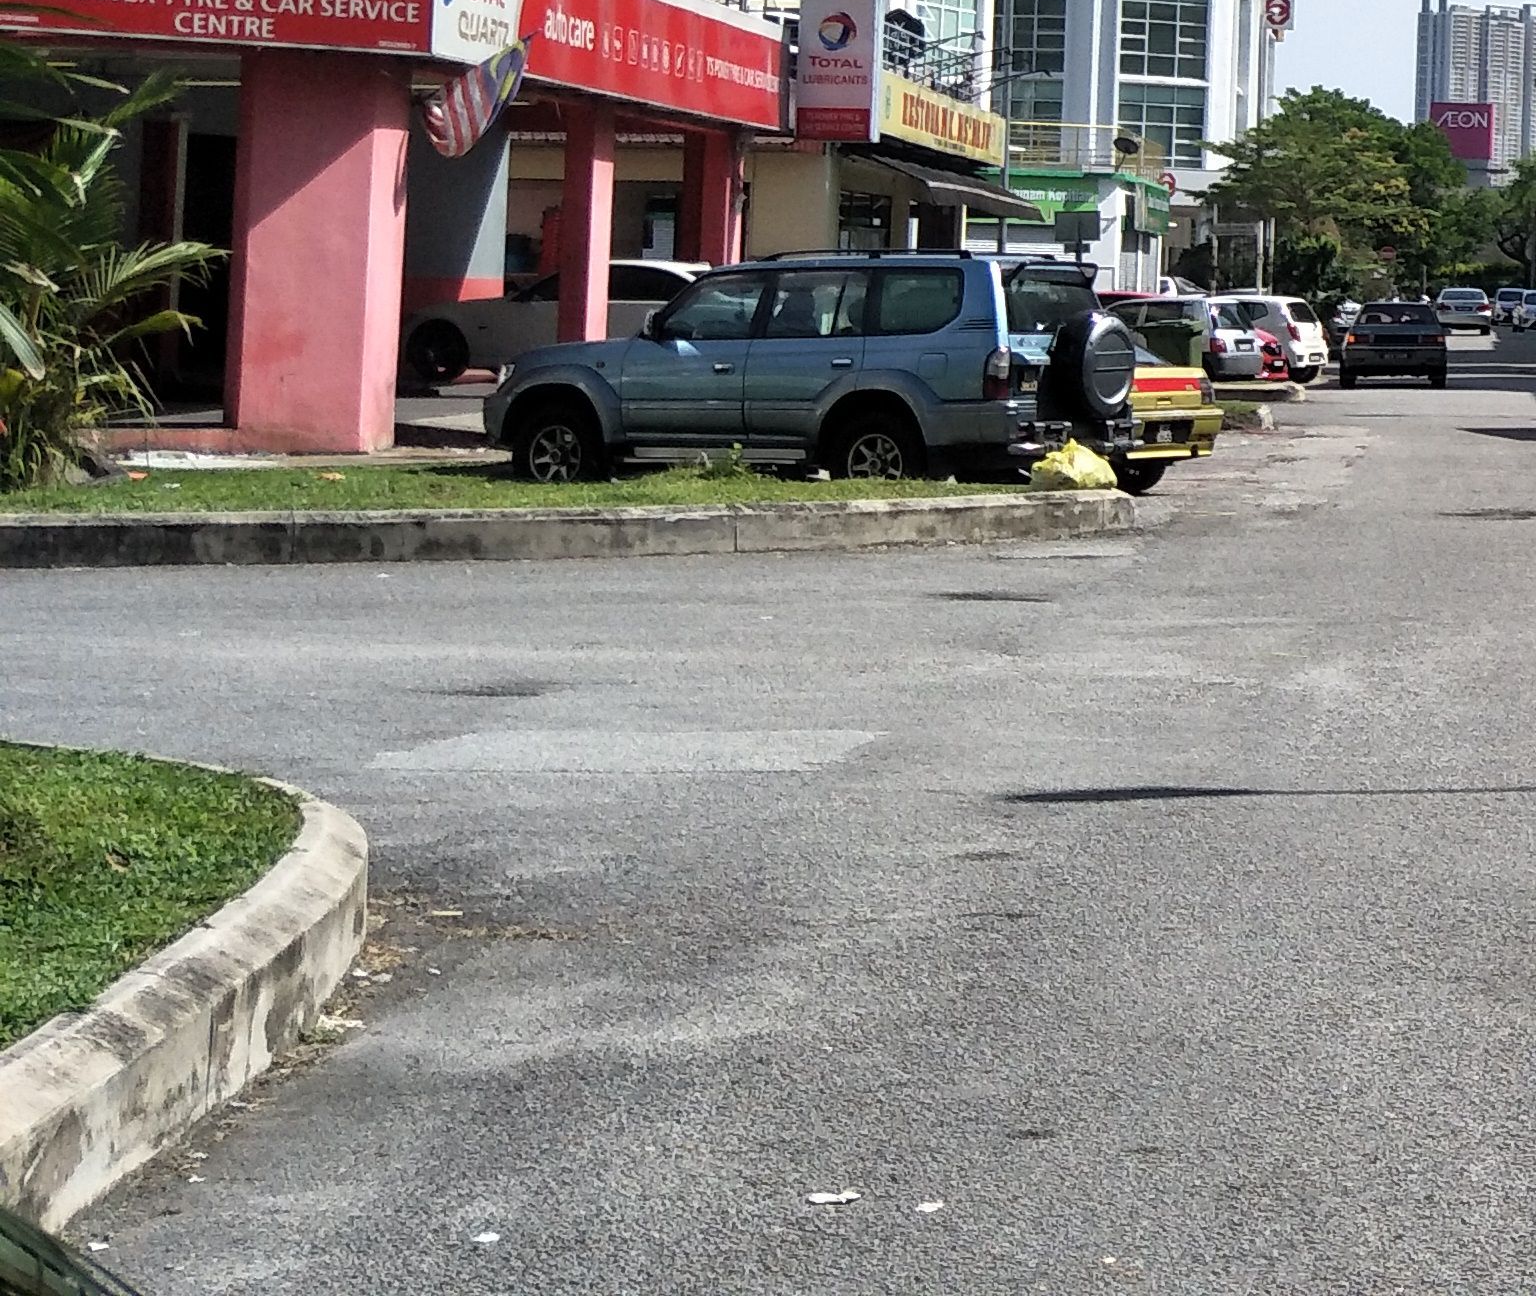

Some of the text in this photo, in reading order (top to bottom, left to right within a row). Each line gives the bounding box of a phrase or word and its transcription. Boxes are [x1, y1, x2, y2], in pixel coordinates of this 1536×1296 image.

[174, 11, 275, 39] CENTRE
[459, 10, 509, 48] QUARTZ
[544, 4, 595, 51] auto care
[809, 56, 863, 69] TOTAL
[802, 74, 868, 85] LUBRICANTS
